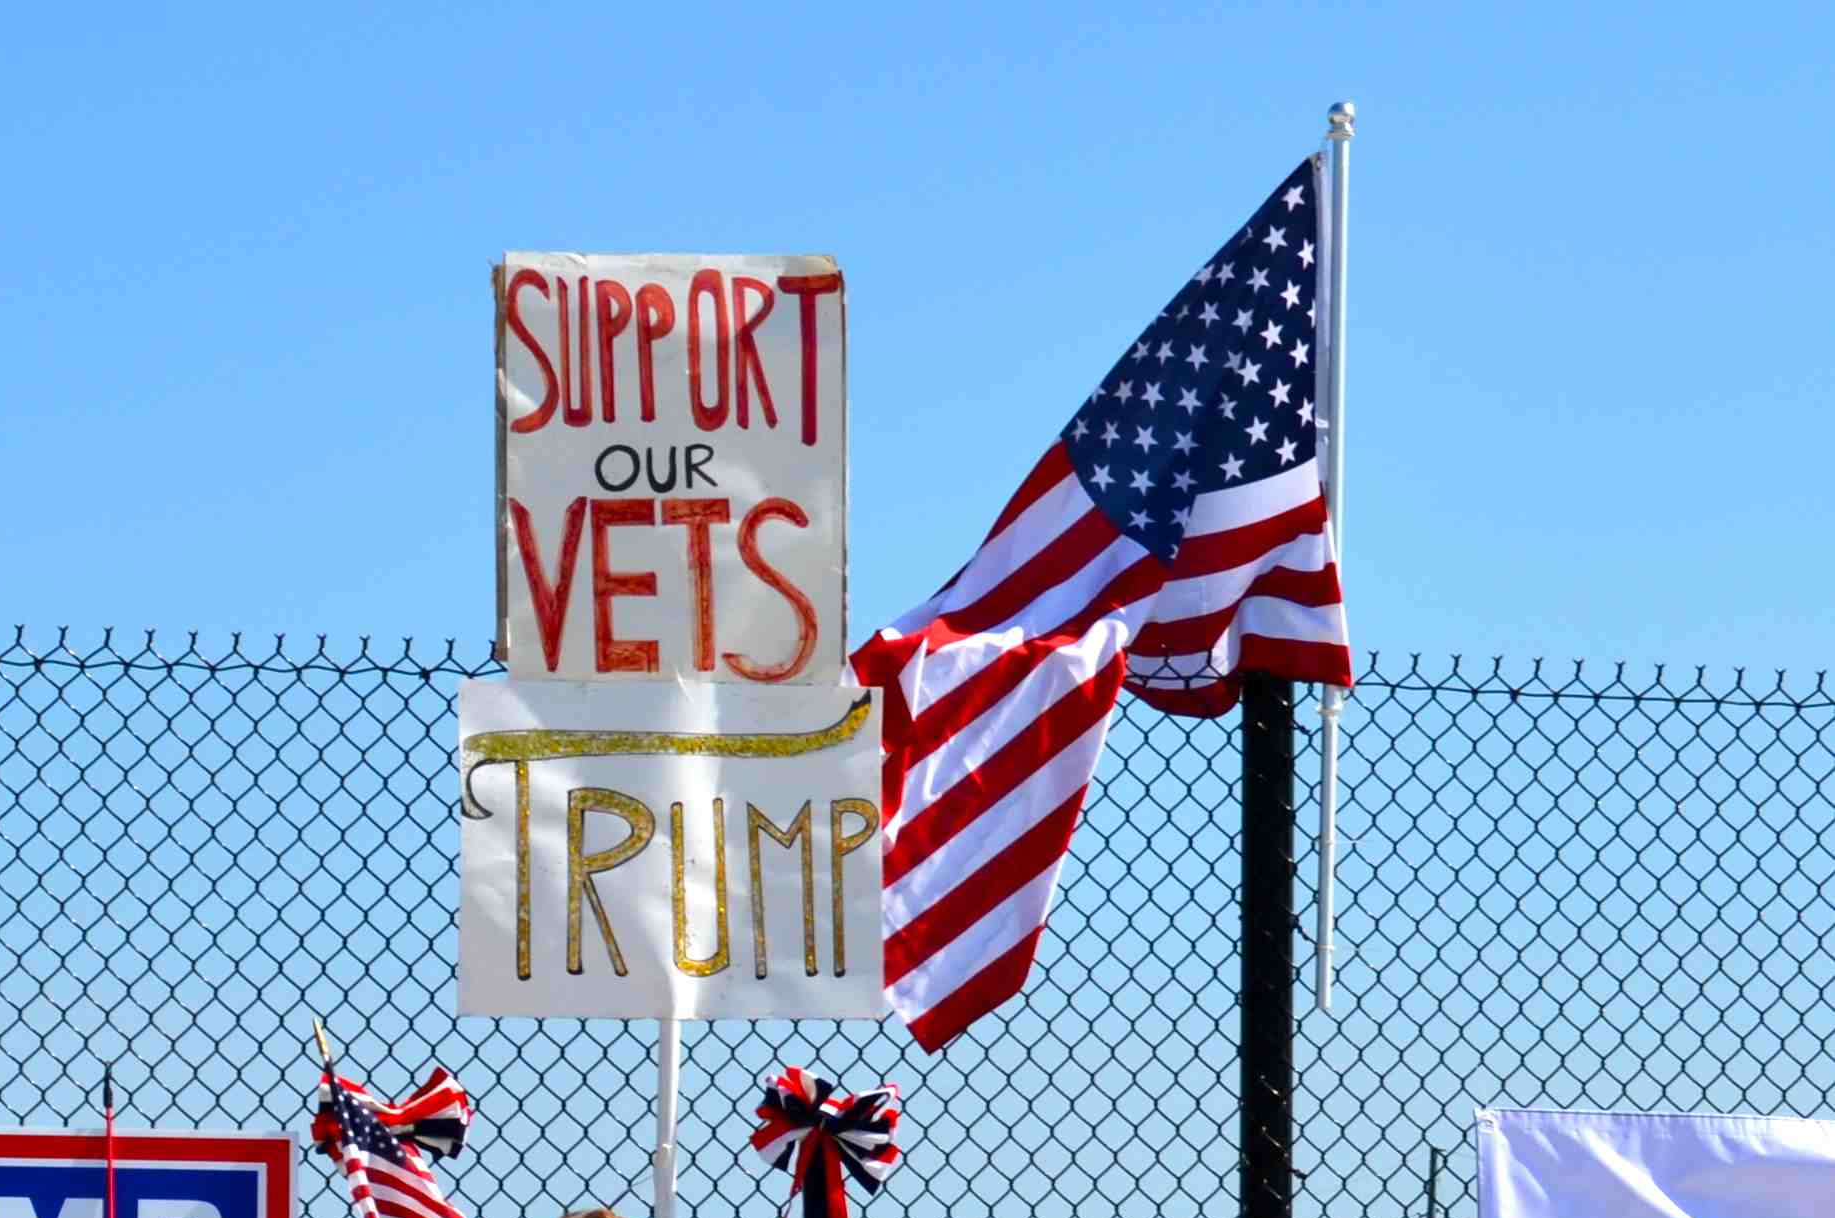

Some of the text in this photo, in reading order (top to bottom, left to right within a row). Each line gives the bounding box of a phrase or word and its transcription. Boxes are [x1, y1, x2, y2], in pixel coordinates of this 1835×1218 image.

[506, 268, 840, 447] SUPPORT
[594, 444, 719, 492] OUR
[508, 497, 818, 681] VETS
[460, 690, 879, 980] TRUMP
